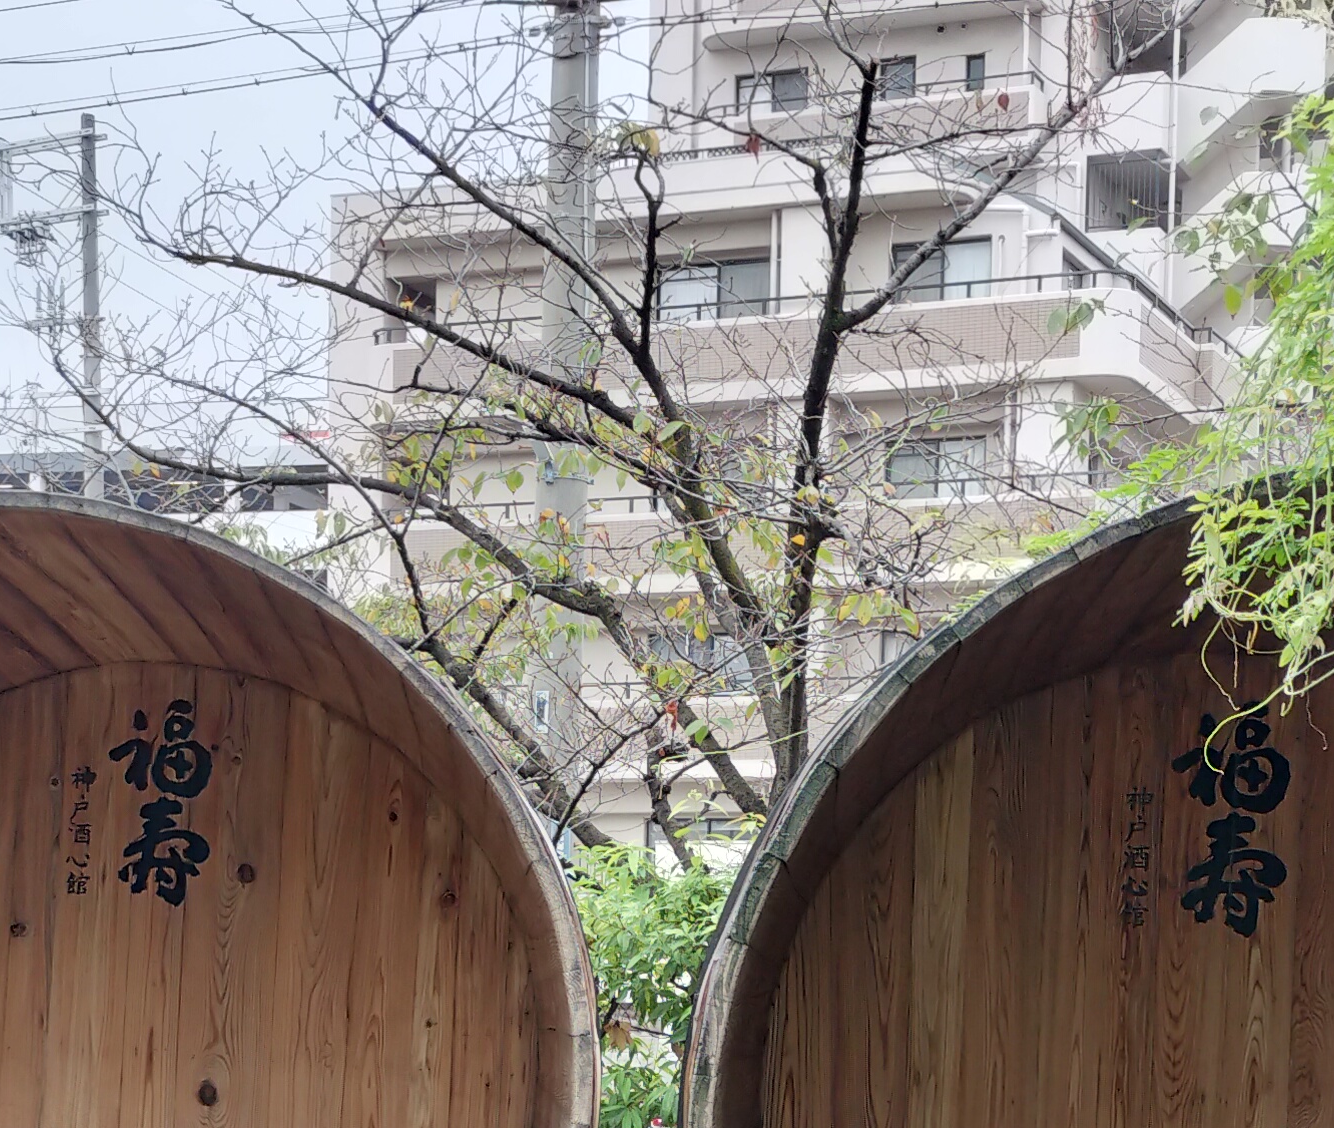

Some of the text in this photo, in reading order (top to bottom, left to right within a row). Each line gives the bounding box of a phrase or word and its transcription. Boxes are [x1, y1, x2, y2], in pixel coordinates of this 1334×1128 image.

[66, 766, 97, 894] 神戸酒心館
[108, 699, 213, 907] 福寿
[1171, 701, 1291, 938] 福寿
